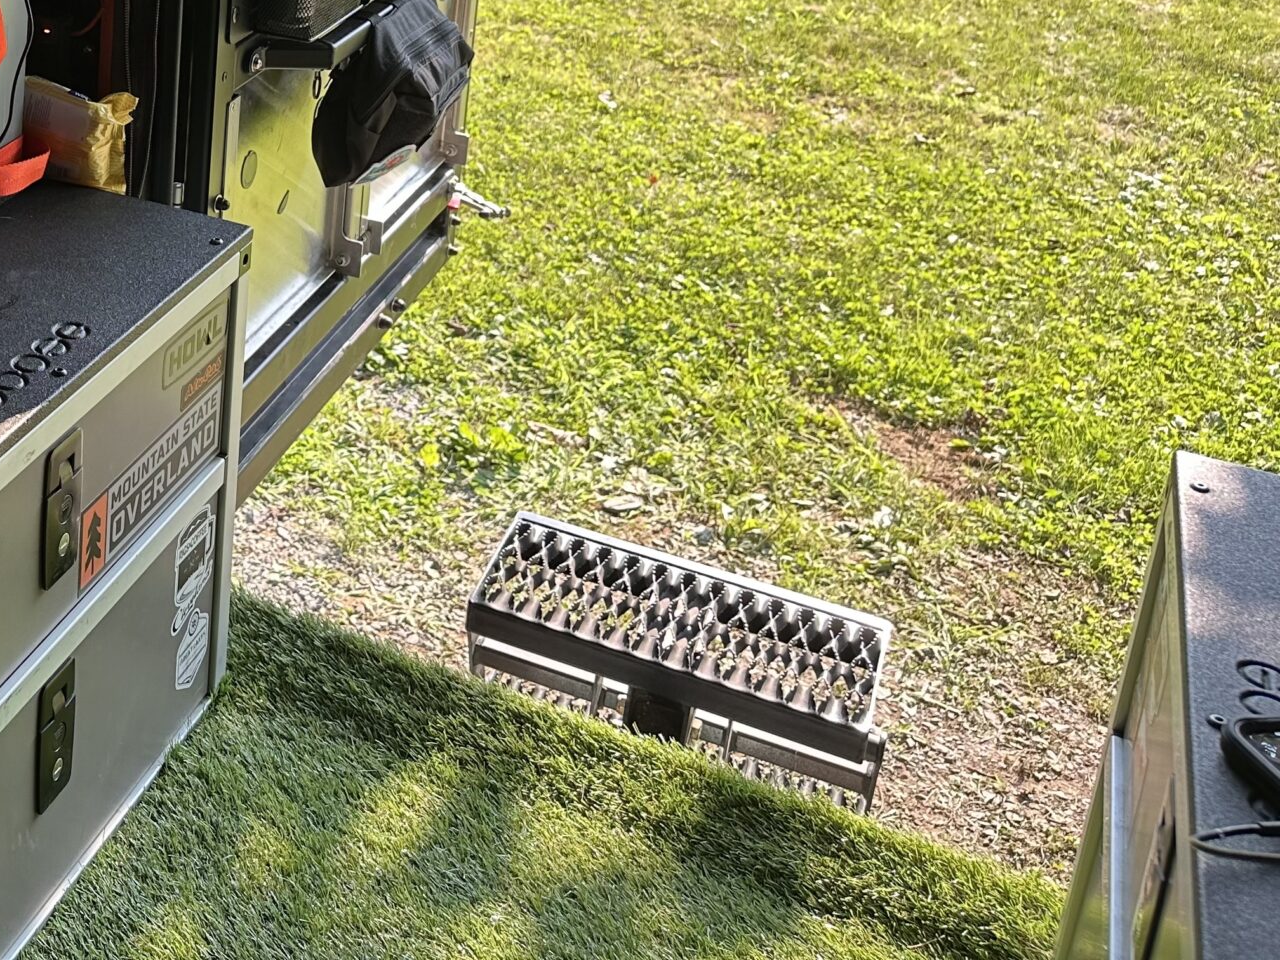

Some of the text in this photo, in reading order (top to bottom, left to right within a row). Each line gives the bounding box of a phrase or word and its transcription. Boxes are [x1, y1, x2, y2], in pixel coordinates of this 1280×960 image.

[168, 314, 223, 378] HOWL
[110, 390, 219, 511] MOUNTAIN STATE
[111, 418, 216, 544] OVERLAND
